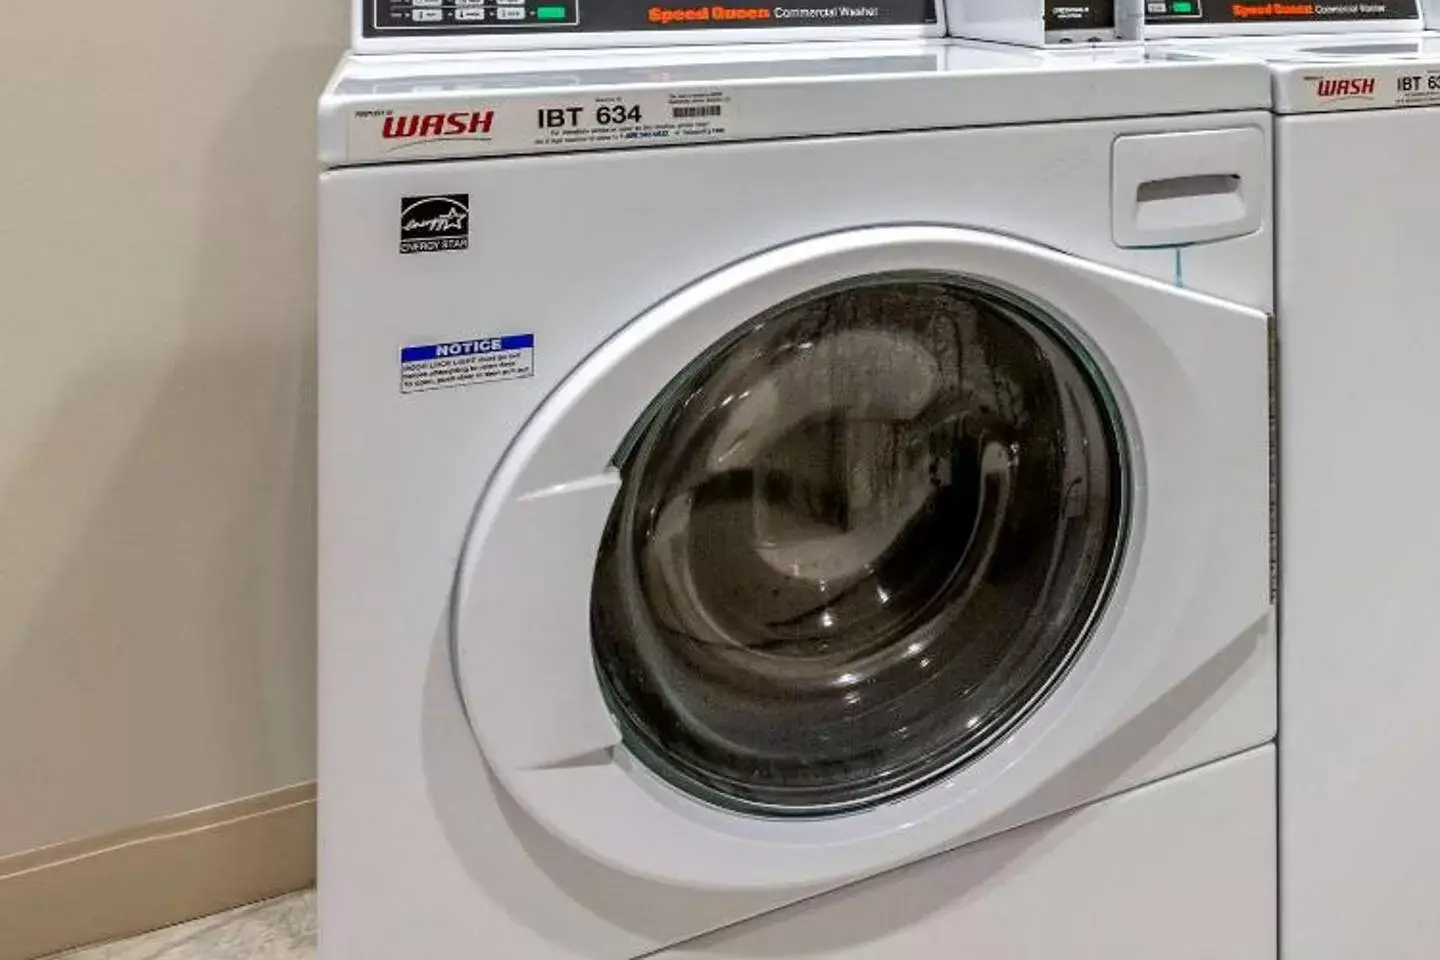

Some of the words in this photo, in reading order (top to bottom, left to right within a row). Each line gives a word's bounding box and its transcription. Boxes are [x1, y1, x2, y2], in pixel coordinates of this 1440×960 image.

[649, 6, 709, 24] Speed
[712, 6, 770, 21] Queen
[774, 6, 838, 19] Commercial
[1317, 78, 1375, 97] WASH
[1397, 76, 1422, 92] IBT
[383, 111, 494, 139] WASH
[537, 107, 583, 129] IBT
[596, 104, 642, 125] 634
[436, 340, 502, 356] NOTICE
